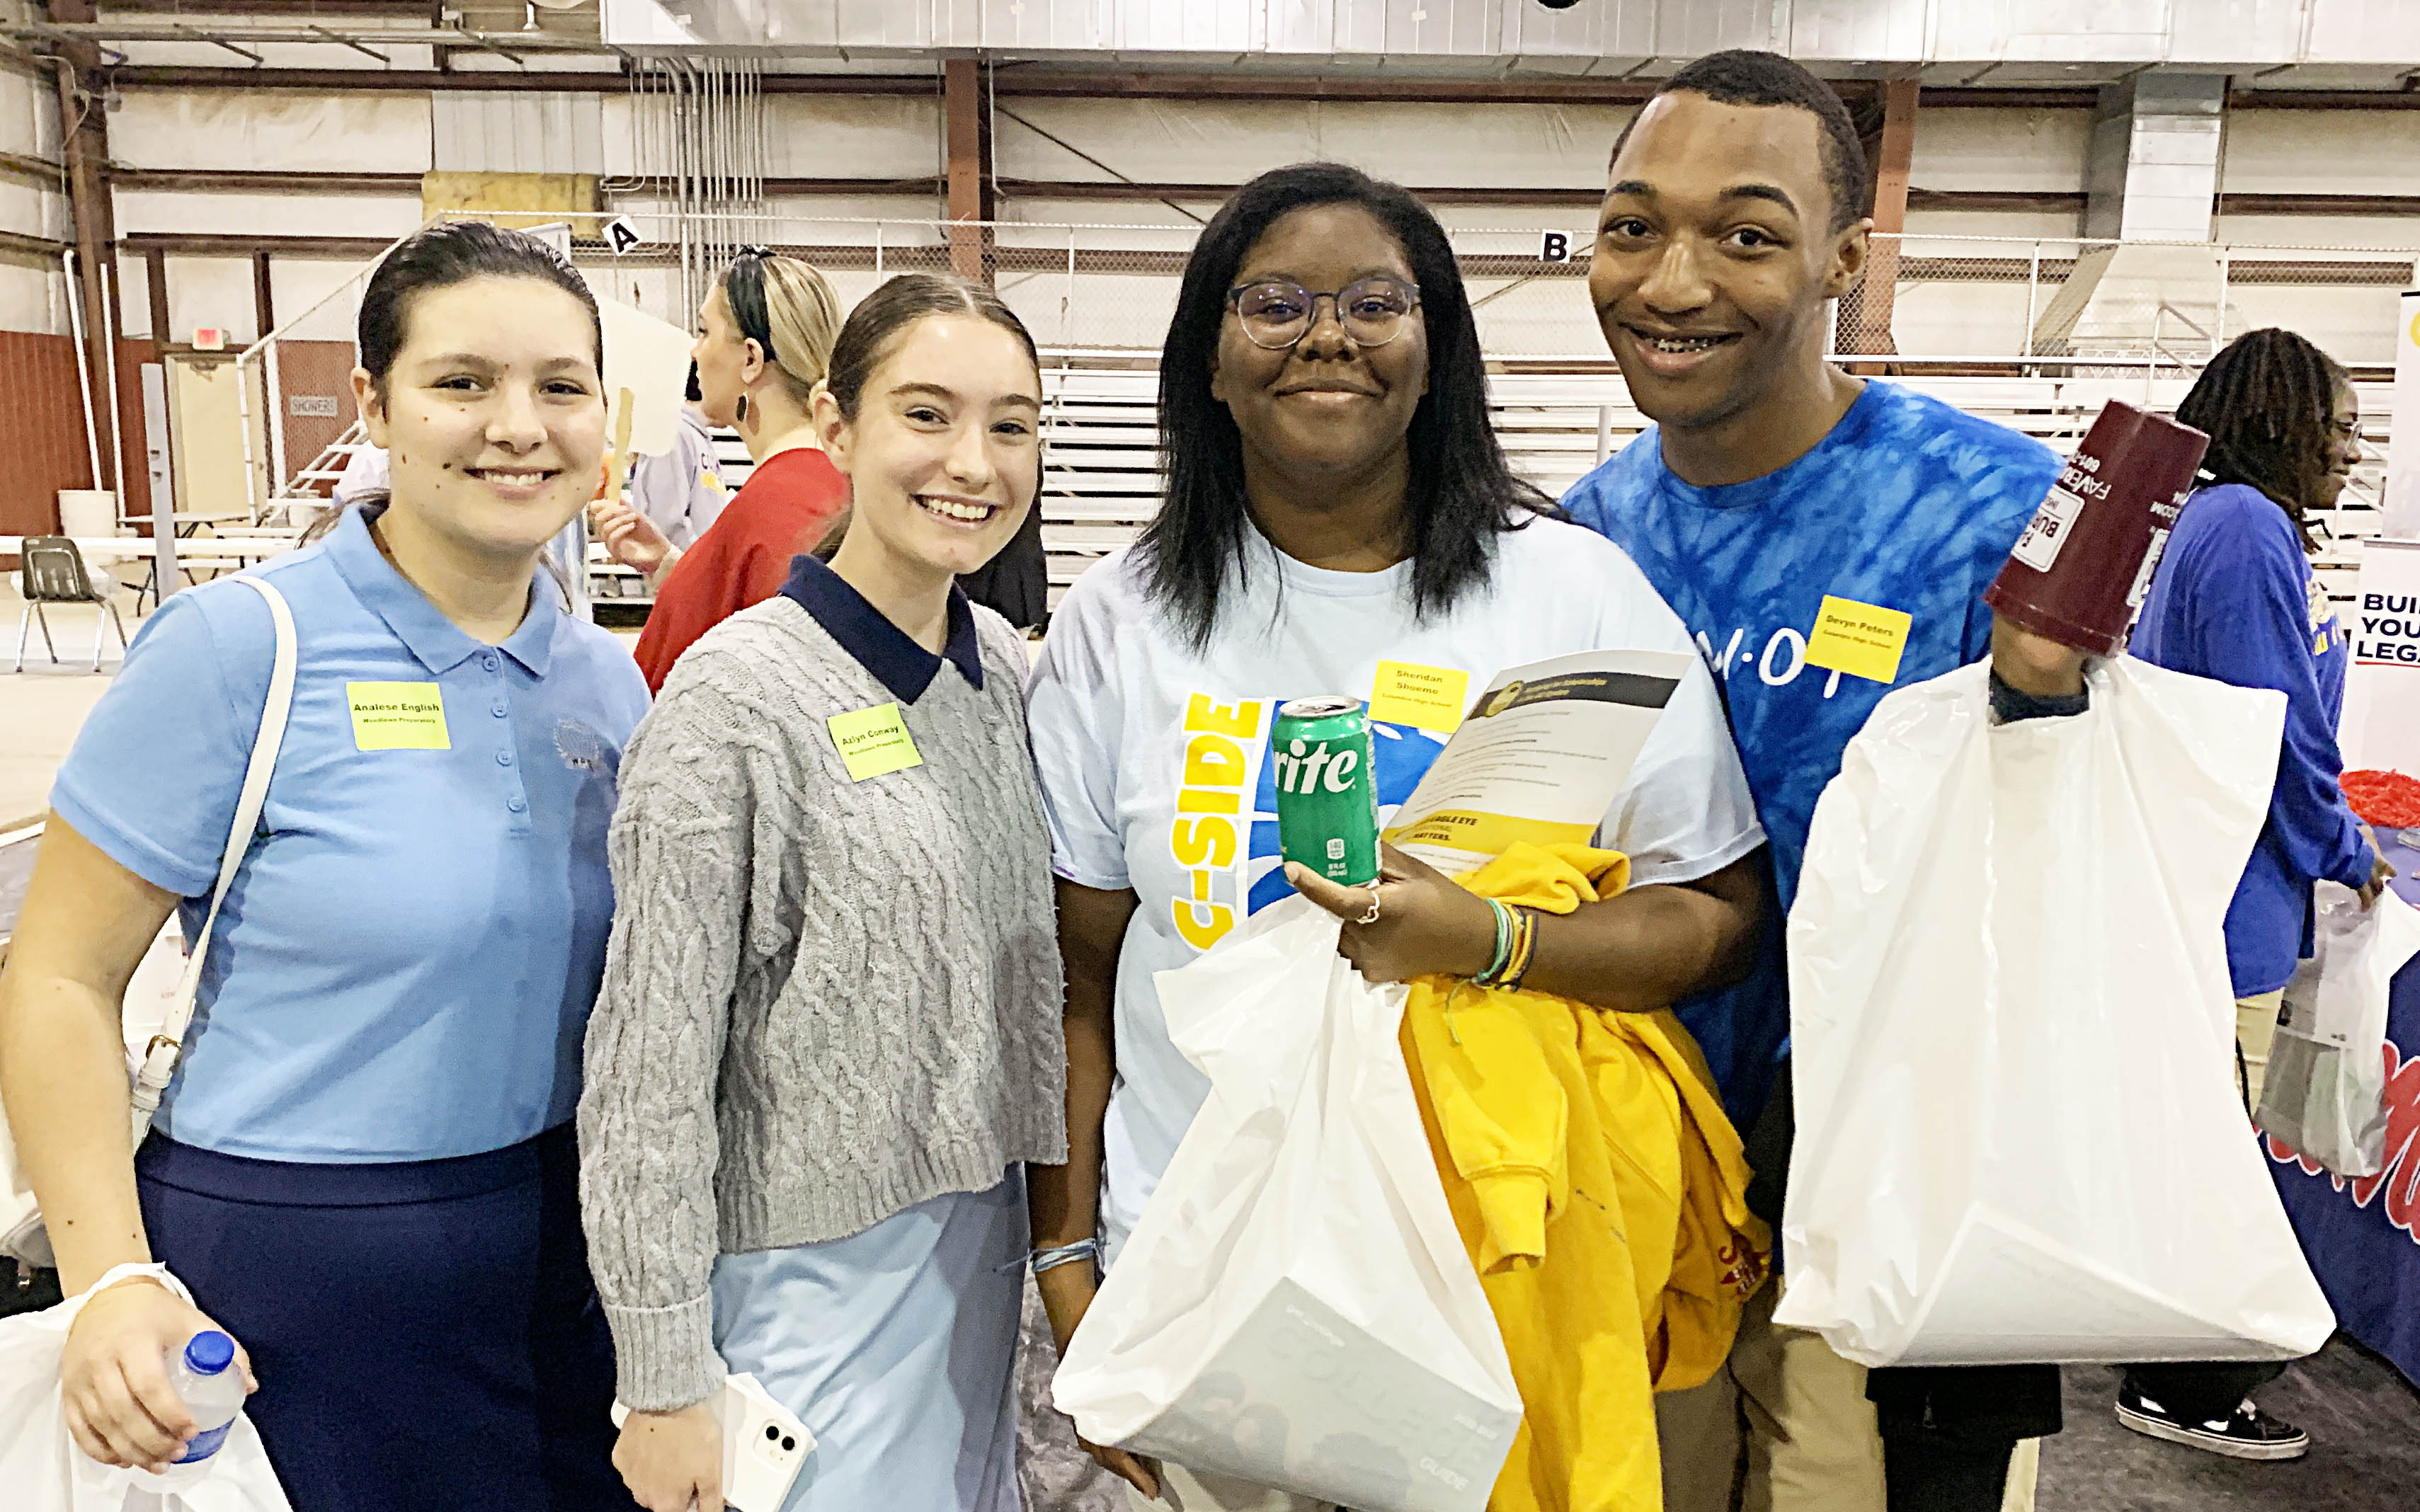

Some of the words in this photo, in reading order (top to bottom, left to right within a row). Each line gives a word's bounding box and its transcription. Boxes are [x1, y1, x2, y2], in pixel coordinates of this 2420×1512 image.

[611, 222, 639, 253] A
[1543, 232, 1568, 262] B
[2363, 593, 2420, 614] BUI
[1859, 622, 1894, 637] Peters
[2361, 617, 2420, 638] YOU
[2357, 640, 2420, 663] LEG
[1396, 670, 1443, 683] Sheridan
[401, 703, 440, 713] English
[867, 726, 898, 738] Conway
[1172, 692, 1262, 951] C-SIDE
[1459, 815, 1478, 826] EYE
[1418, 1456, 1470, 1491] GUIDE
